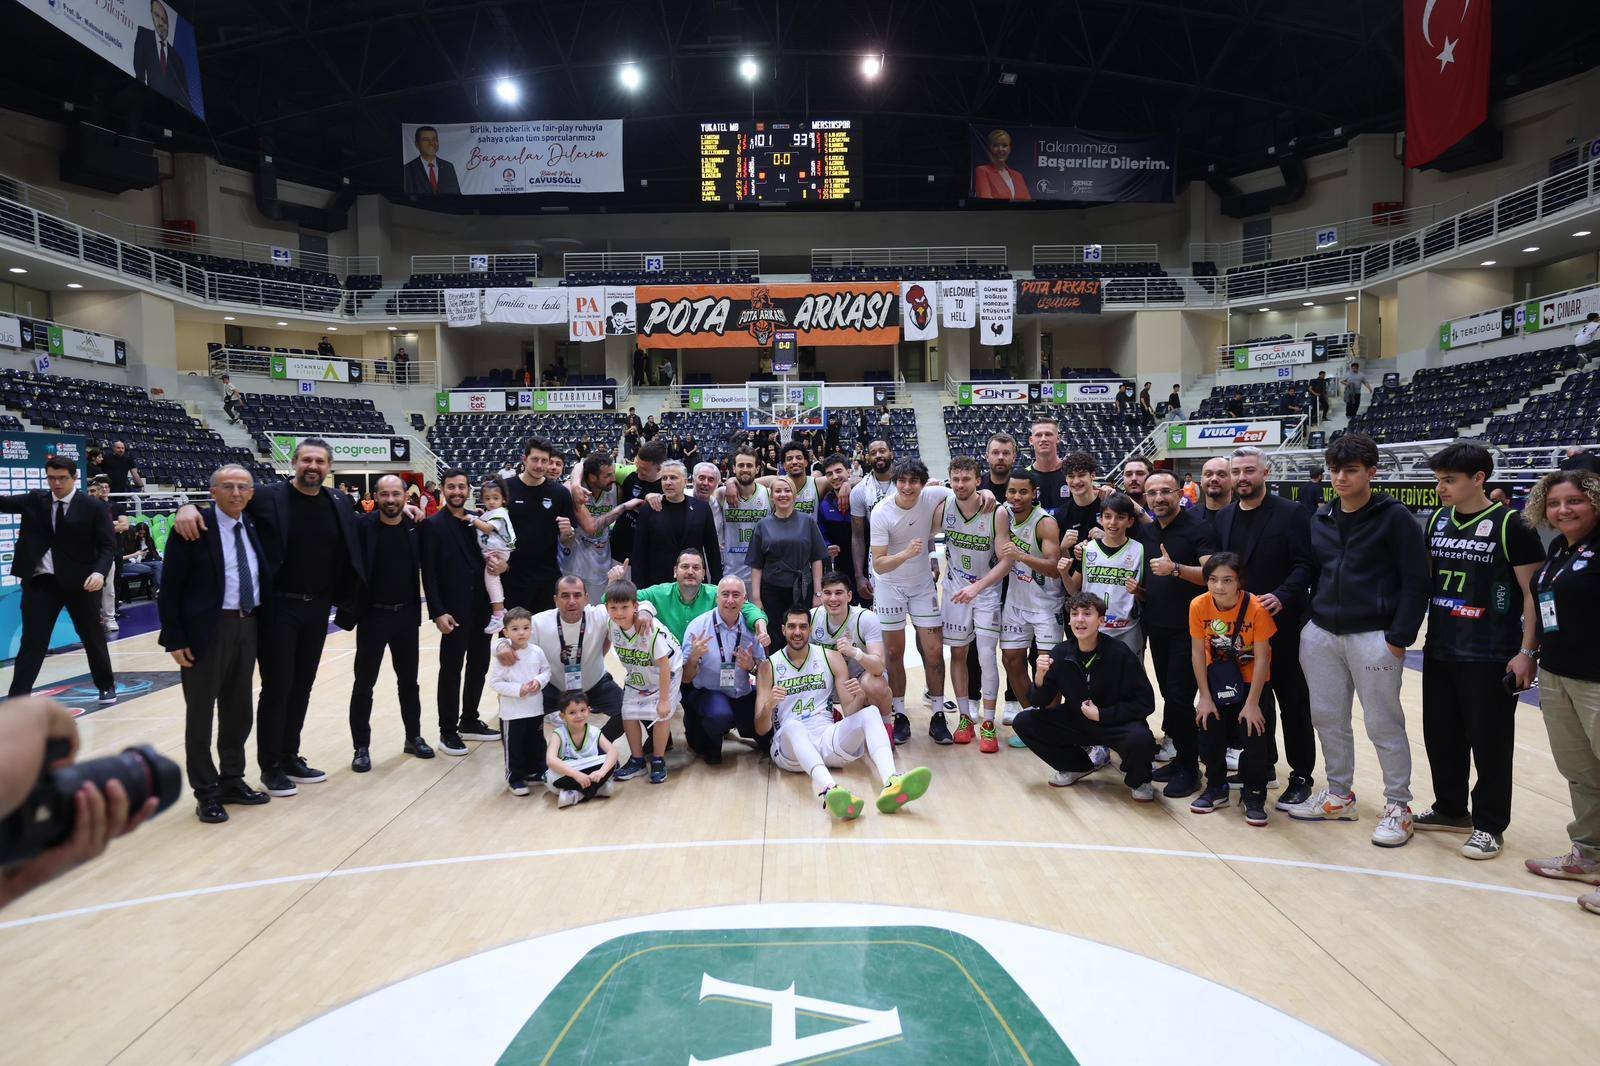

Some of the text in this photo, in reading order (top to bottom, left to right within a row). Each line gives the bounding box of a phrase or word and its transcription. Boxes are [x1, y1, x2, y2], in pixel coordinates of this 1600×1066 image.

[470, 125, 492, 134] Birlik,
[493, 124, 531, 133] beraberlik
[542, 123, 574, 134] fair-play
[575, 123, 603, 133] ruhuyla
[700, 123, 728, 132] YUKATEL
[478, 133, 596, 145] sahaya çıkan tüm sporcularımıza
[793, 133, 808, 147] 93
[1038, 140, 1118, 155] Takımımıza
[547, 142, 608, 167] Dilerim
[1037, 155, 1171, 172] Başarılar Dilerim.
[779, 173, 786, 183] 4
[1085, 247, 1100, 260] F5
[647, 258, 662, 271] F3
[943, 286, 976, 298] WELCOME
[1021, 281, 1049, 296] POTA
[576, 297, 599, 313] PA
[955, 299, 964, 310] TO
[643, 292, 894, 335] POTA ARKASI
[738, 309, 759, 325] POTA
[950, 311, 967, 322] HELL
[572, 320, 605, 337] UNI
[1254, 349, 1305, 362] GOCAMAN
[39, 356, 50, 372] A5
[1278, 368, 1290, 377] B5
[302, 382, 312, 391] B1
[1042, 386, 1053, 395] B4
[520, 394, 531, 403] B2
[1204, 427, 1264, 442] YUKA tel
[331, 445, 387, 457] cogreen
[1438, 569, 1468, 593] 77
[792, 698, 815, 716] 44
